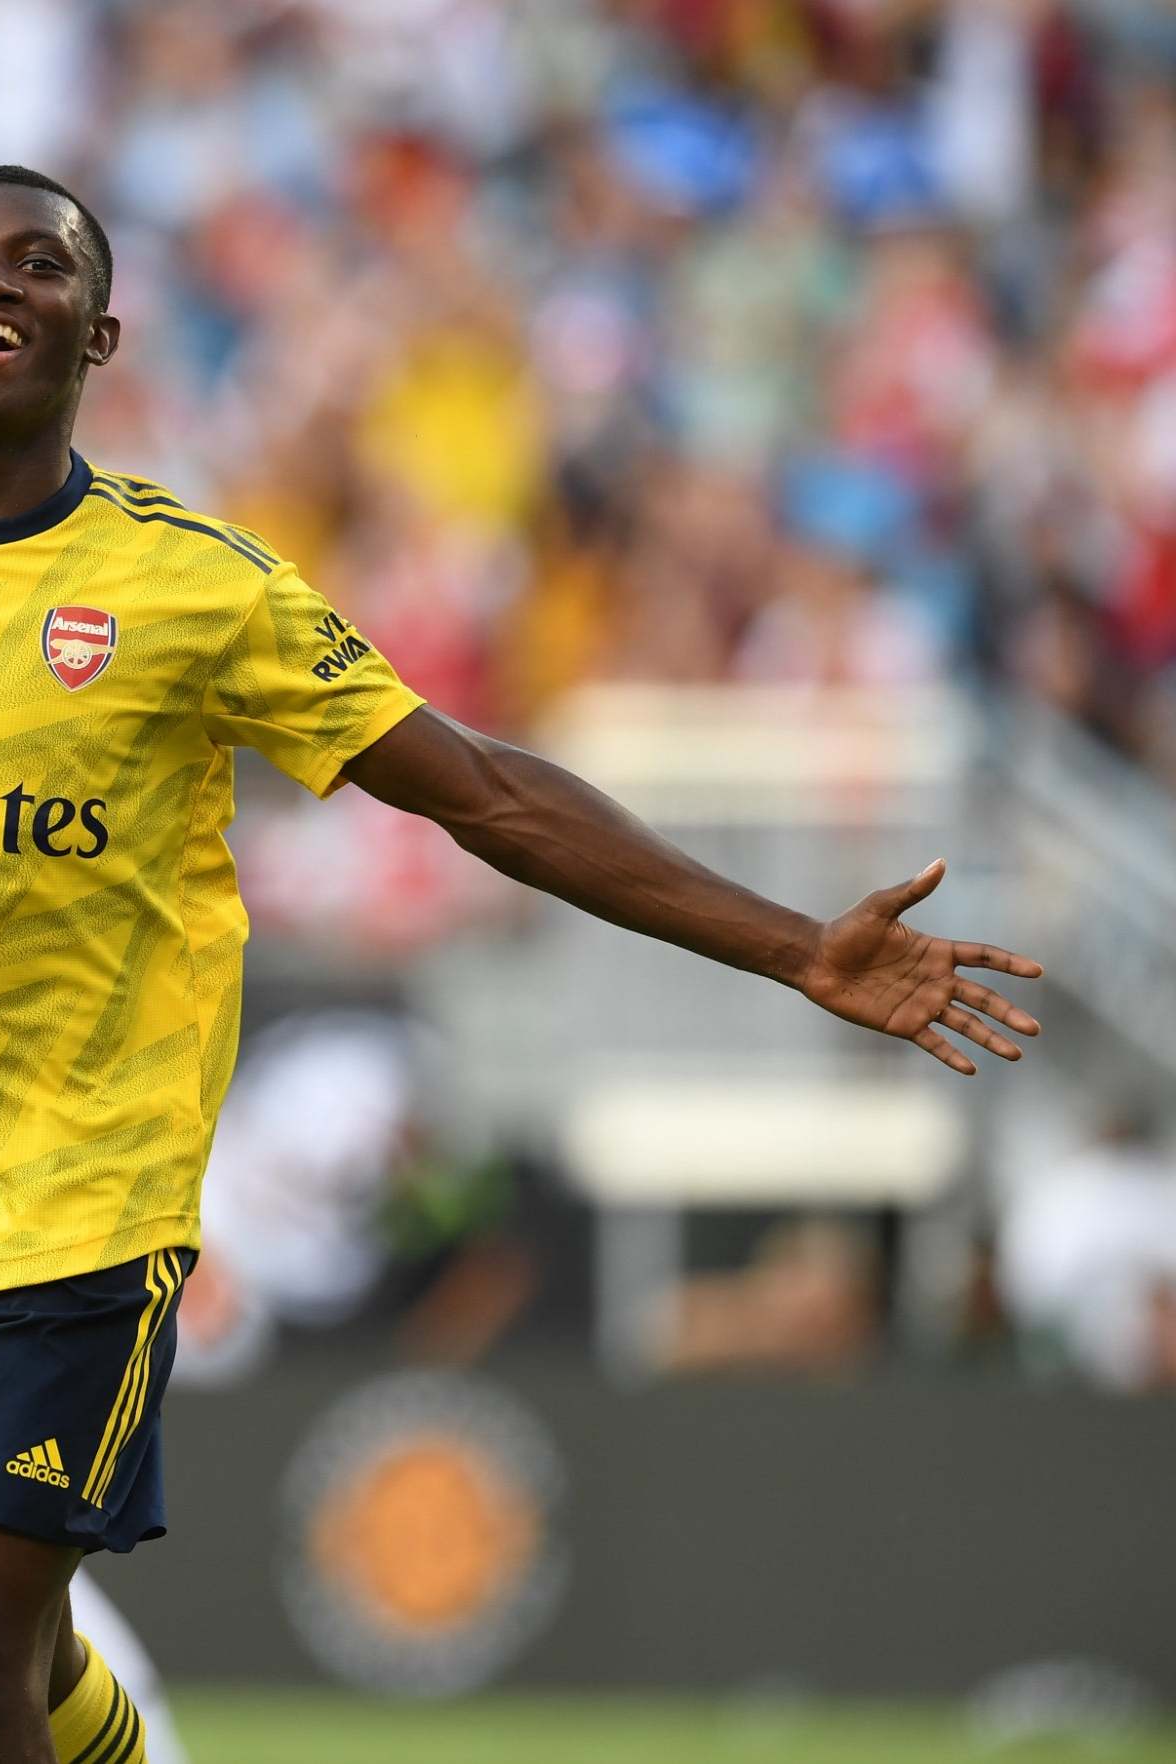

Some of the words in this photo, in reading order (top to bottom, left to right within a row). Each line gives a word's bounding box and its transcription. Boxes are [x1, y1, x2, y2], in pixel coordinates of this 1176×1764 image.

[51, 616, 109, 636] Arsenal
[314, 611, 351, 642] VI
[5, 1460, 70, 1489] adidas
